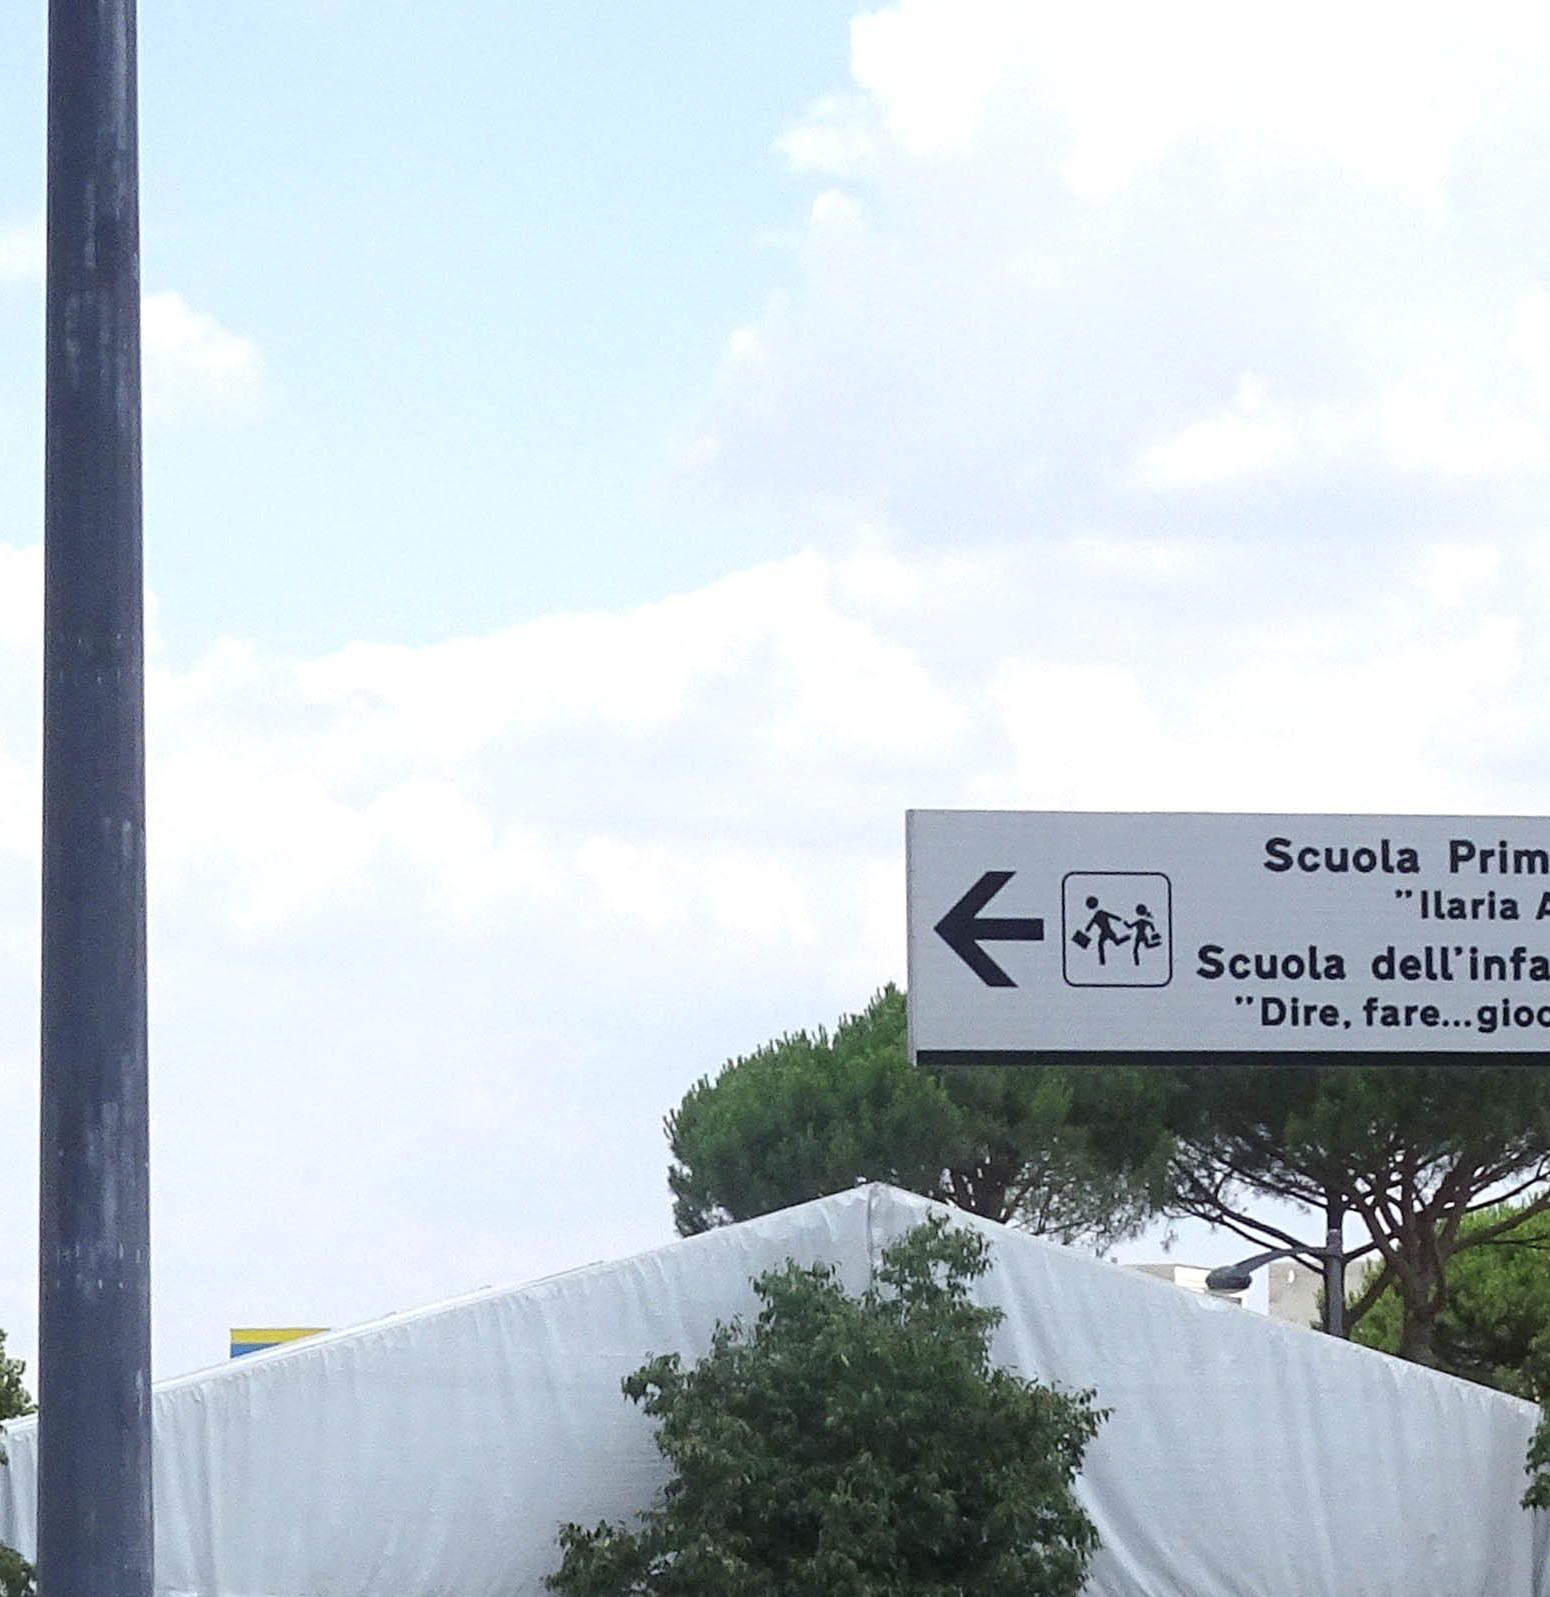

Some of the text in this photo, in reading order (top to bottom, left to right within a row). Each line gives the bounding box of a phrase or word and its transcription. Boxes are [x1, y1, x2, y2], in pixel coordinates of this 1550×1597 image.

[1263, 837, 1420, 873] Scuola
[1395, 890, 1519, 920] "Ilaria
[1196, 944, 1346, 980] Scuola
[1235, 996, 1351, 1029] "Dire,
